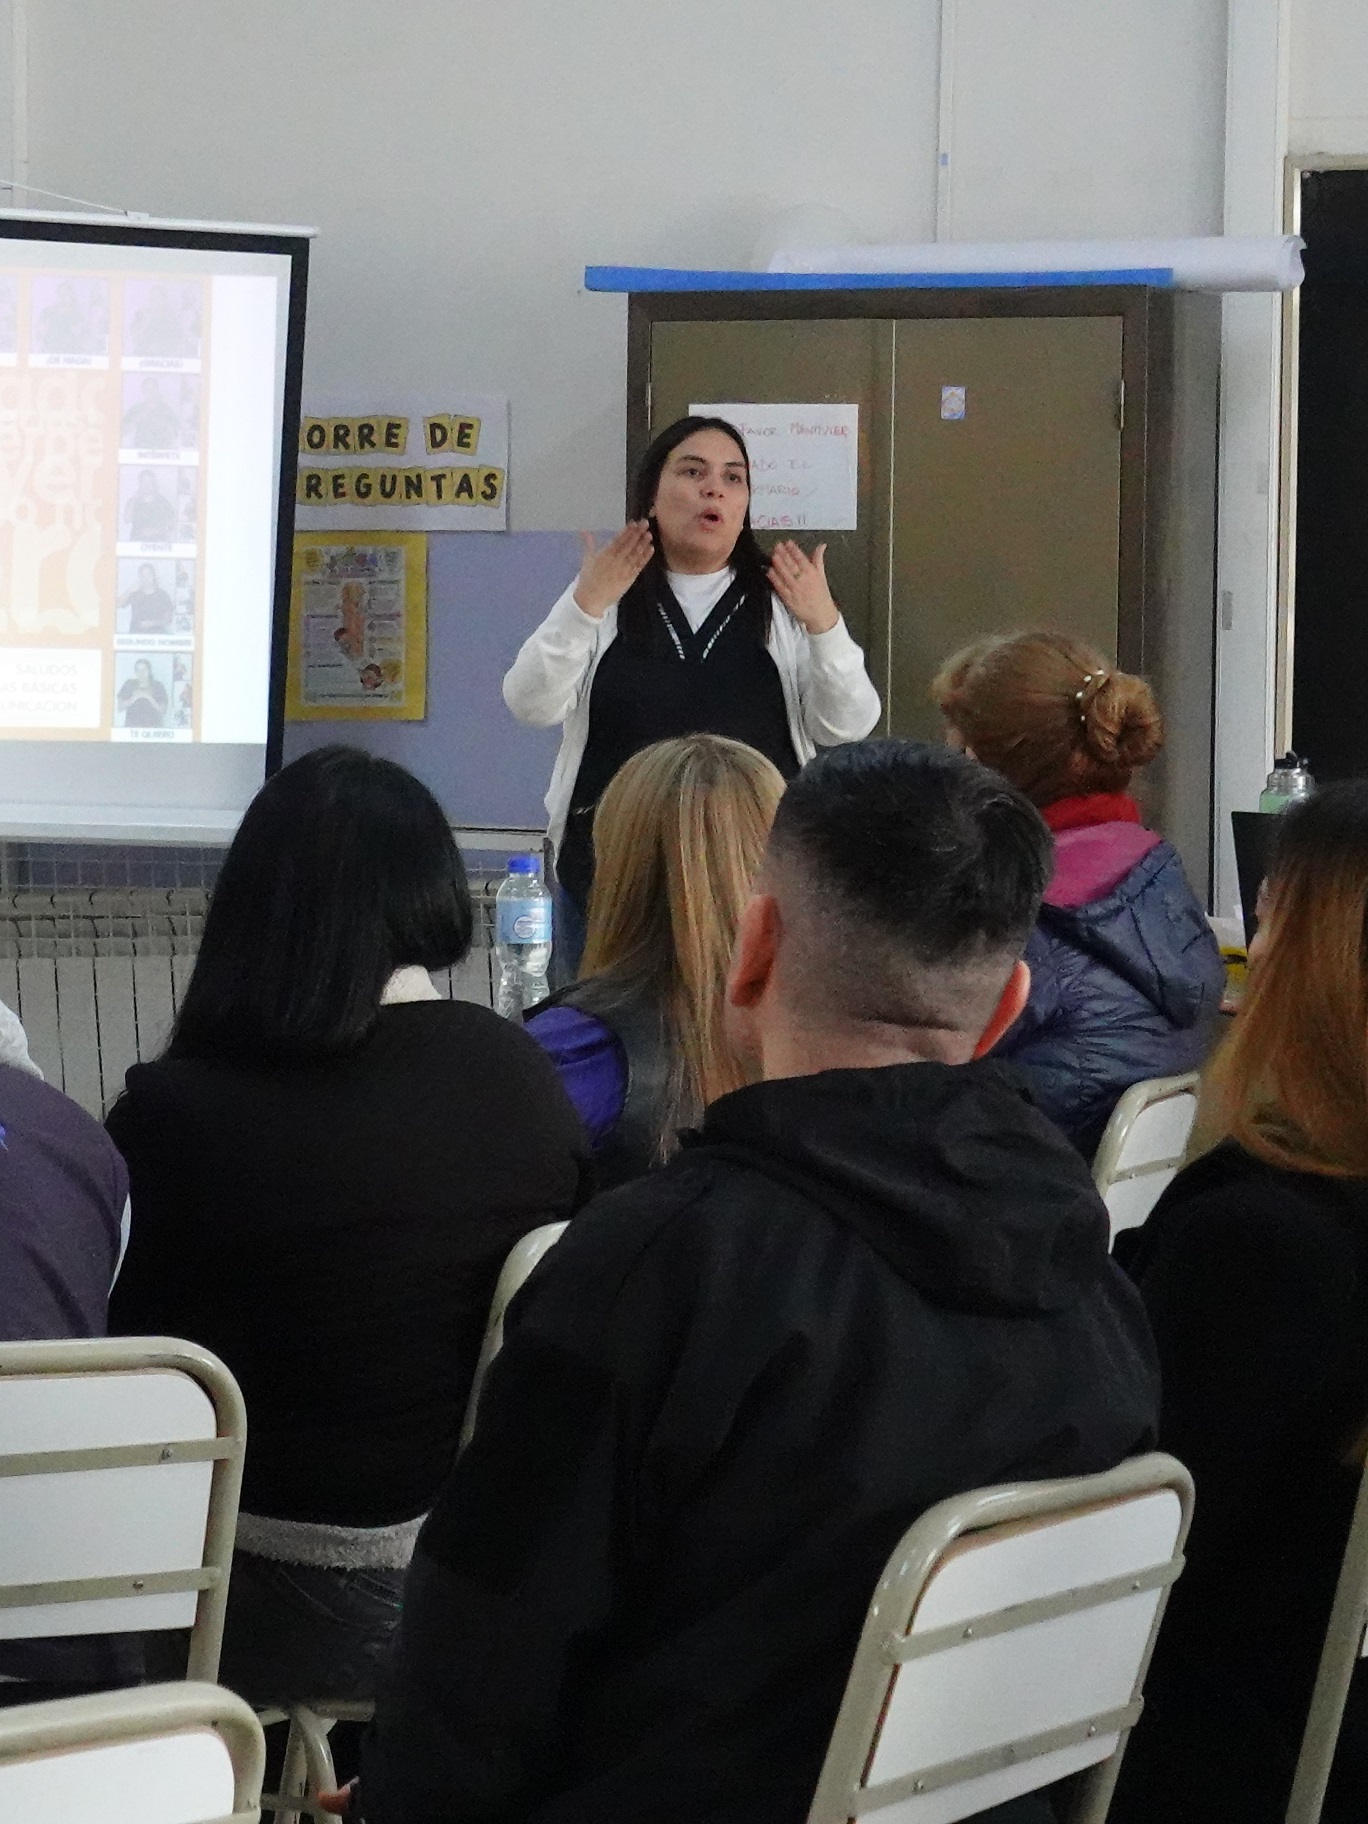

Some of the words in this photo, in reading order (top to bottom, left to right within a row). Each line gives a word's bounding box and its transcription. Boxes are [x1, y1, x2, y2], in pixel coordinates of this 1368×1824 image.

[306, 423, 402, 449] ORRE
[429, 422, 474, 449] DE
[305, 472, 498, 500] REGUNTAS
[15, 663, 78, 676] SALUDOS
[21, 678, 78, 695] BÁSICAS
